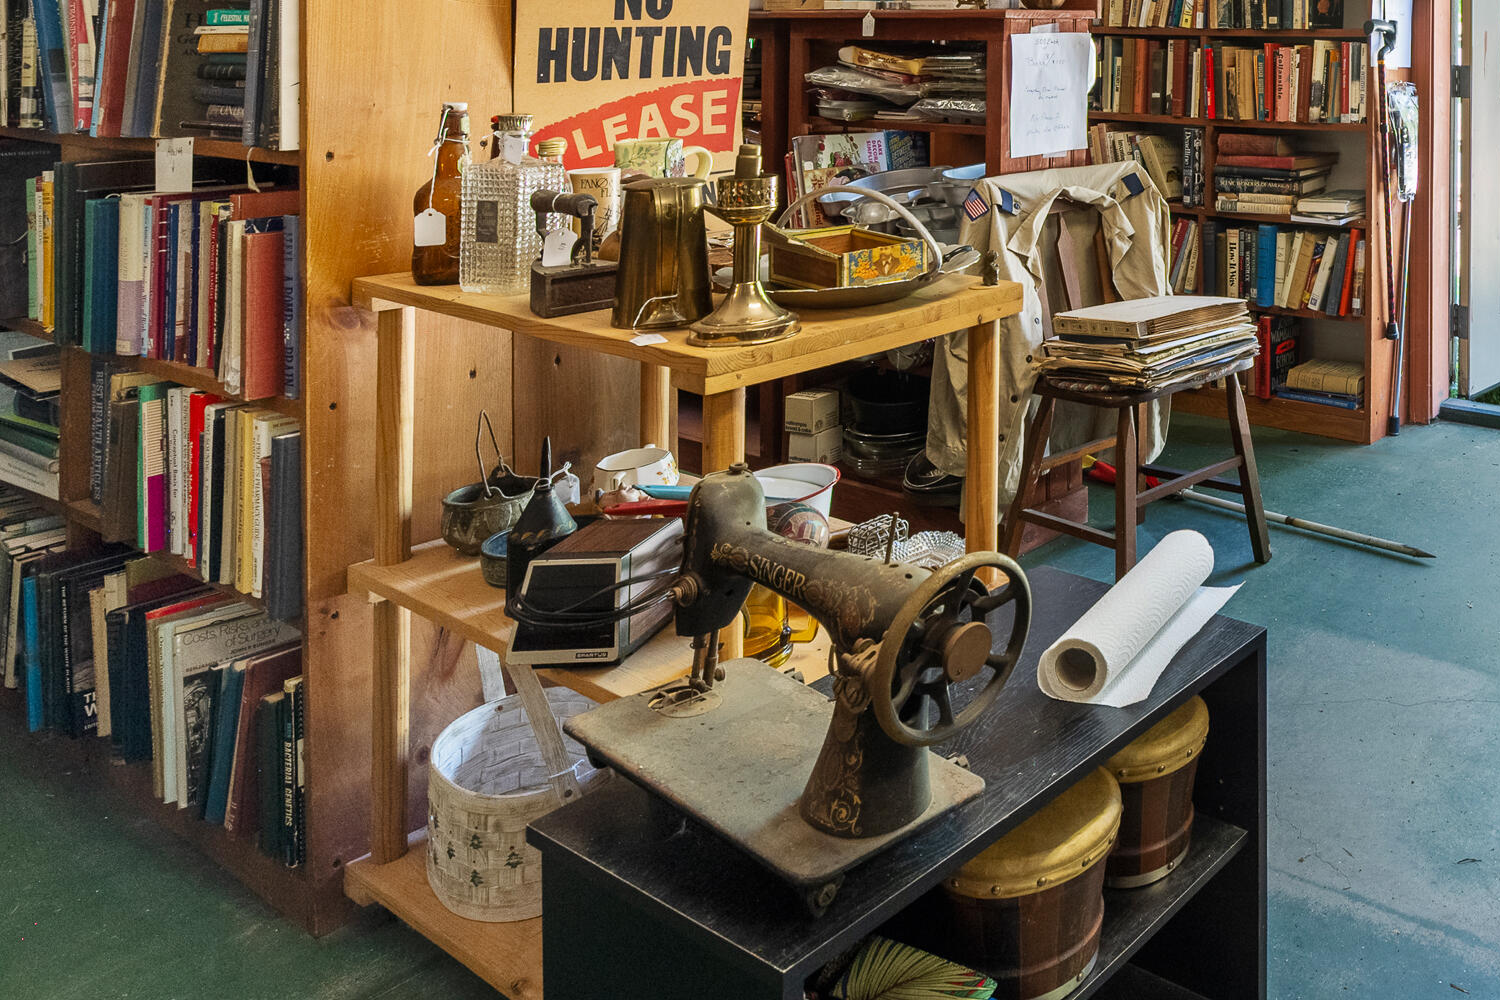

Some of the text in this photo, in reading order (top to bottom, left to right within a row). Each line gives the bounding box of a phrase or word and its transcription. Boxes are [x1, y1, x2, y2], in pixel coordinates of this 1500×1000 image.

[537, 26, 732, 83] HUNTING
[1184, 131, 1192, 165] Deadline
[1229, 242, 1237, 262] How
[1229, 270, 1237, 287] Was
[95, 370, 104, 399] BEST
[94, 448, 103, 501] ARTICLES
[749, 554, 806, 601] SINGER
[237, 625, 282, 648] Surgery
[553, 679, 581, 699] MURPHY
[284, 742, 292, 826] BACTERIAL GENETICS
